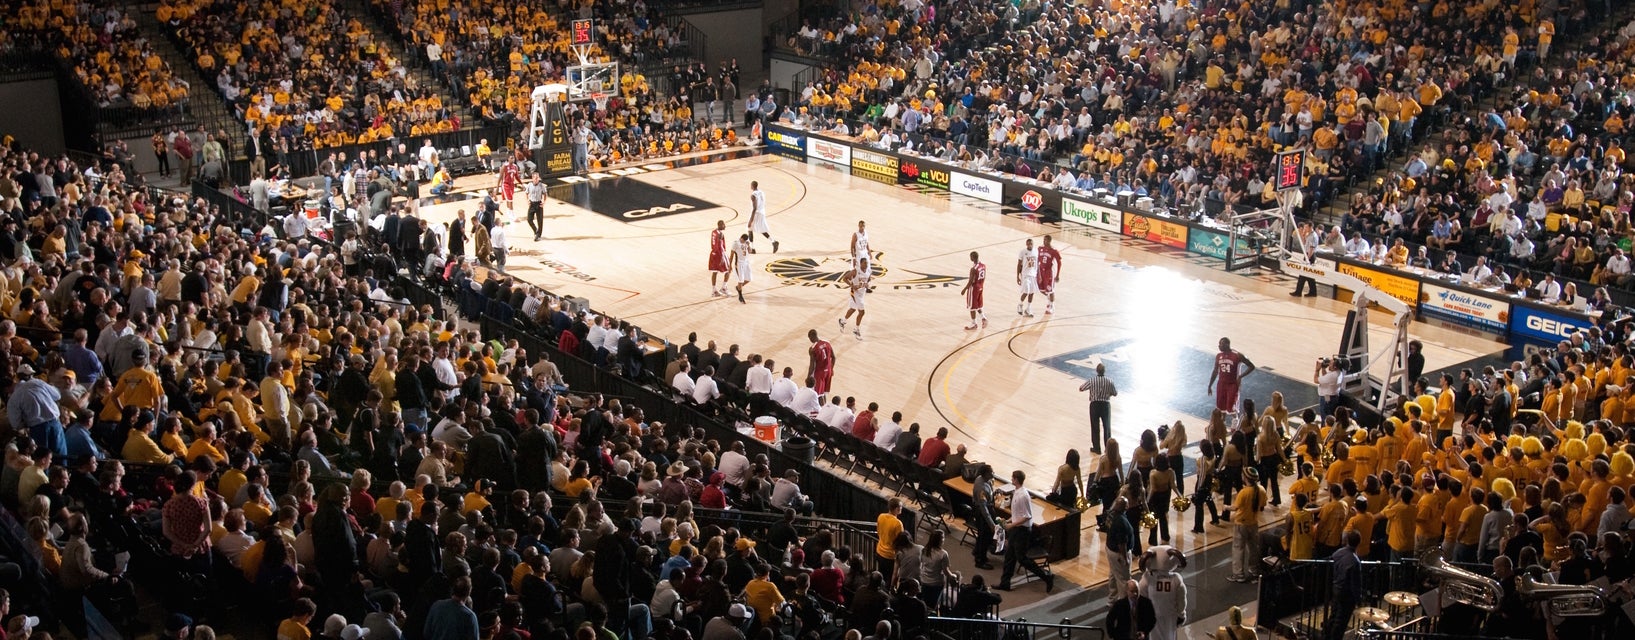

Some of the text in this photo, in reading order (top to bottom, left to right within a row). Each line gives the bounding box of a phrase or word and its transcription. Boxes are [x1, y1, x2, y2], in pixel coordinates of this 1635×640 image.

[552, 120, 562, 144] VCU
[547, 159, 572, 167] BUREAU
[553, 152, 571, 160] FARM
[921, 171, 929, 179] at
[930, 169, 949, 184] VCU
[1282, 165, 1297, 186] 35
[963, 180, 990, 194] CapTech
[1025, 194, 1039, 208] DQ
[622, 203, 696, 218] CAA
[1063, 200, 1098, 223] Ukrop's
[1194, 241, 1217, 254] Virginia
[1286, 262, 1325, 276] VCU RAMS
[1342, 267, 1373, 284] Village
[1449, 293, 1472, 304] Quick
[1472, 298, 1493, 310] Lane
[1220, 363, 1231, 373] 24
[757, 429, 765, 438] G
[1515, 477, 1526, 490] 15
[1306, 490, 1317, 503] 15
[1298, 520, 1310, 534] 15
[1156, 581, 1171, 593] 00
